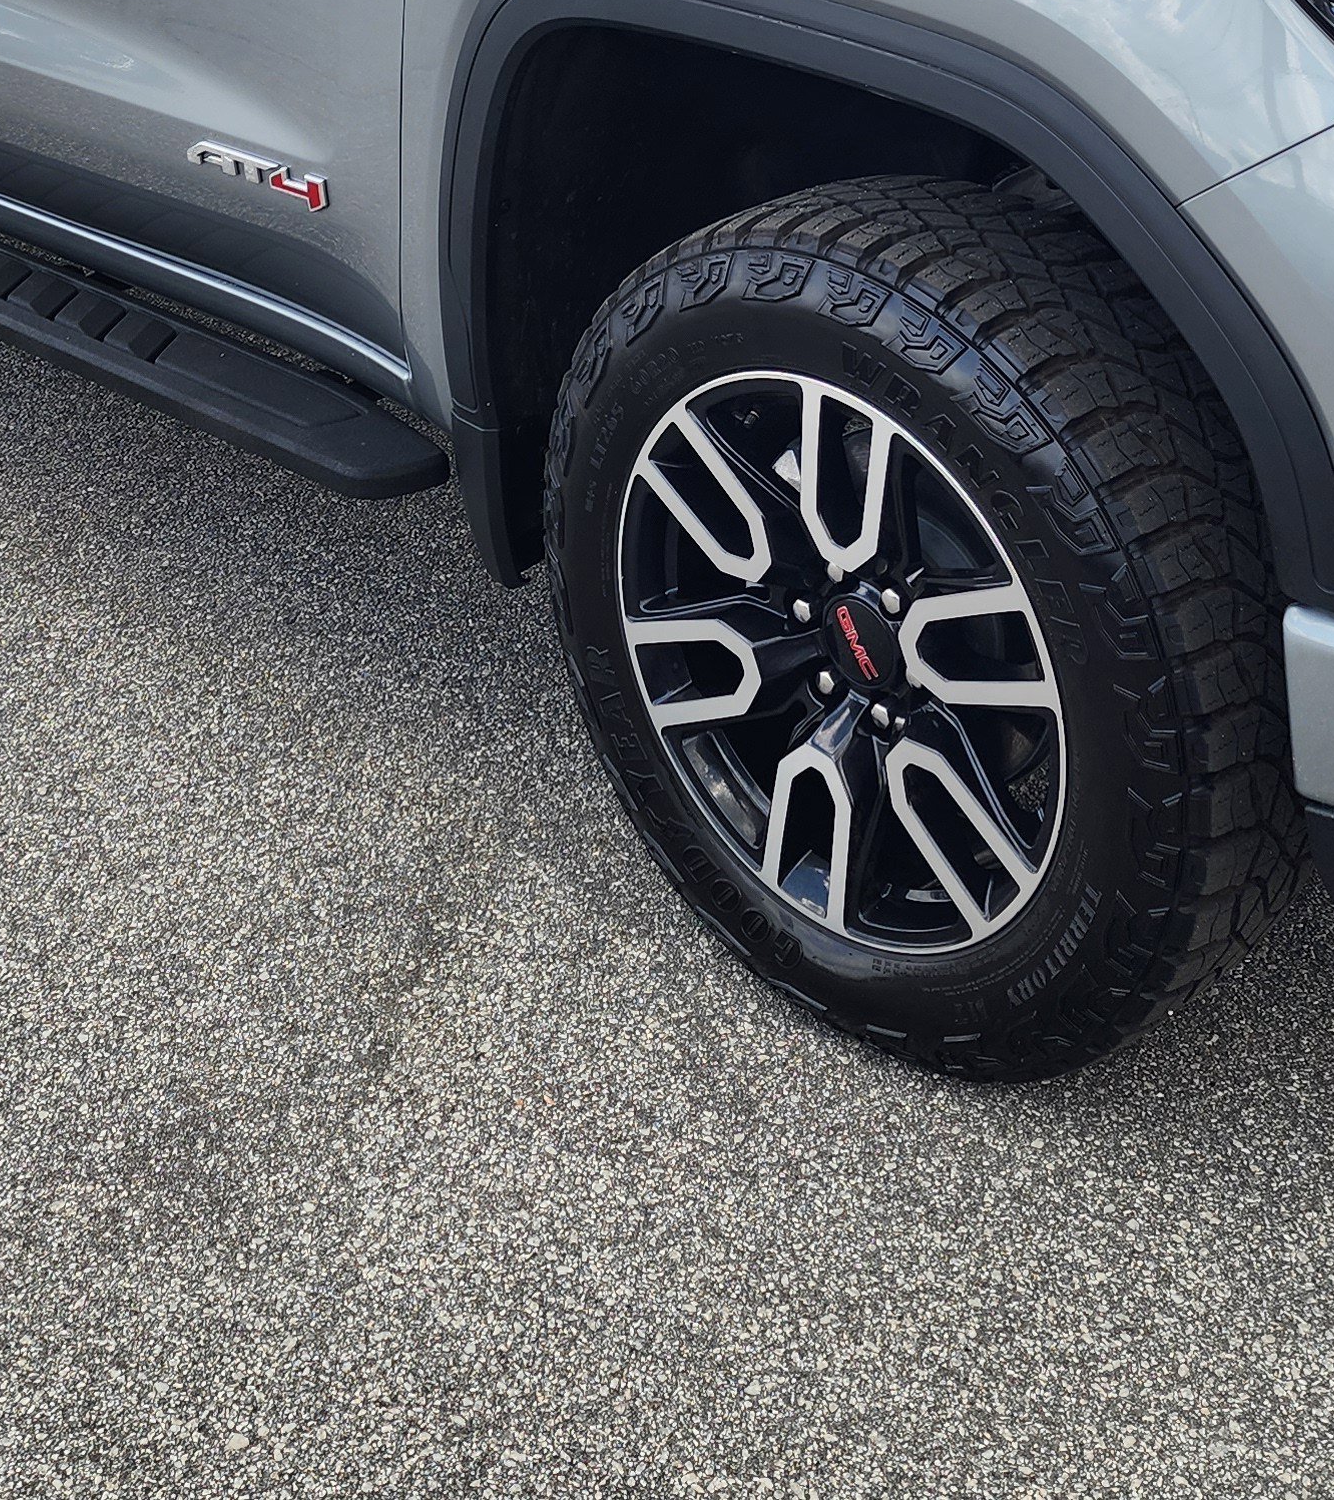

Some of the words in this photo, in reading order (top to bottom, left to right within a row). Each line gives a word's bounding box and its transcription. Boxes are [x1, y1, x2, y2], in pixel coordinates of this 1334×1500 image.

[186, 138, 329, 212] AT4
[841, 341, 1090, 666] WRANGLER
[836, 605, 879, 681] GMC
[586, 645, 804, 968] GOODYEAR
[1006, 882, 1103, 1007] TERRITORY
